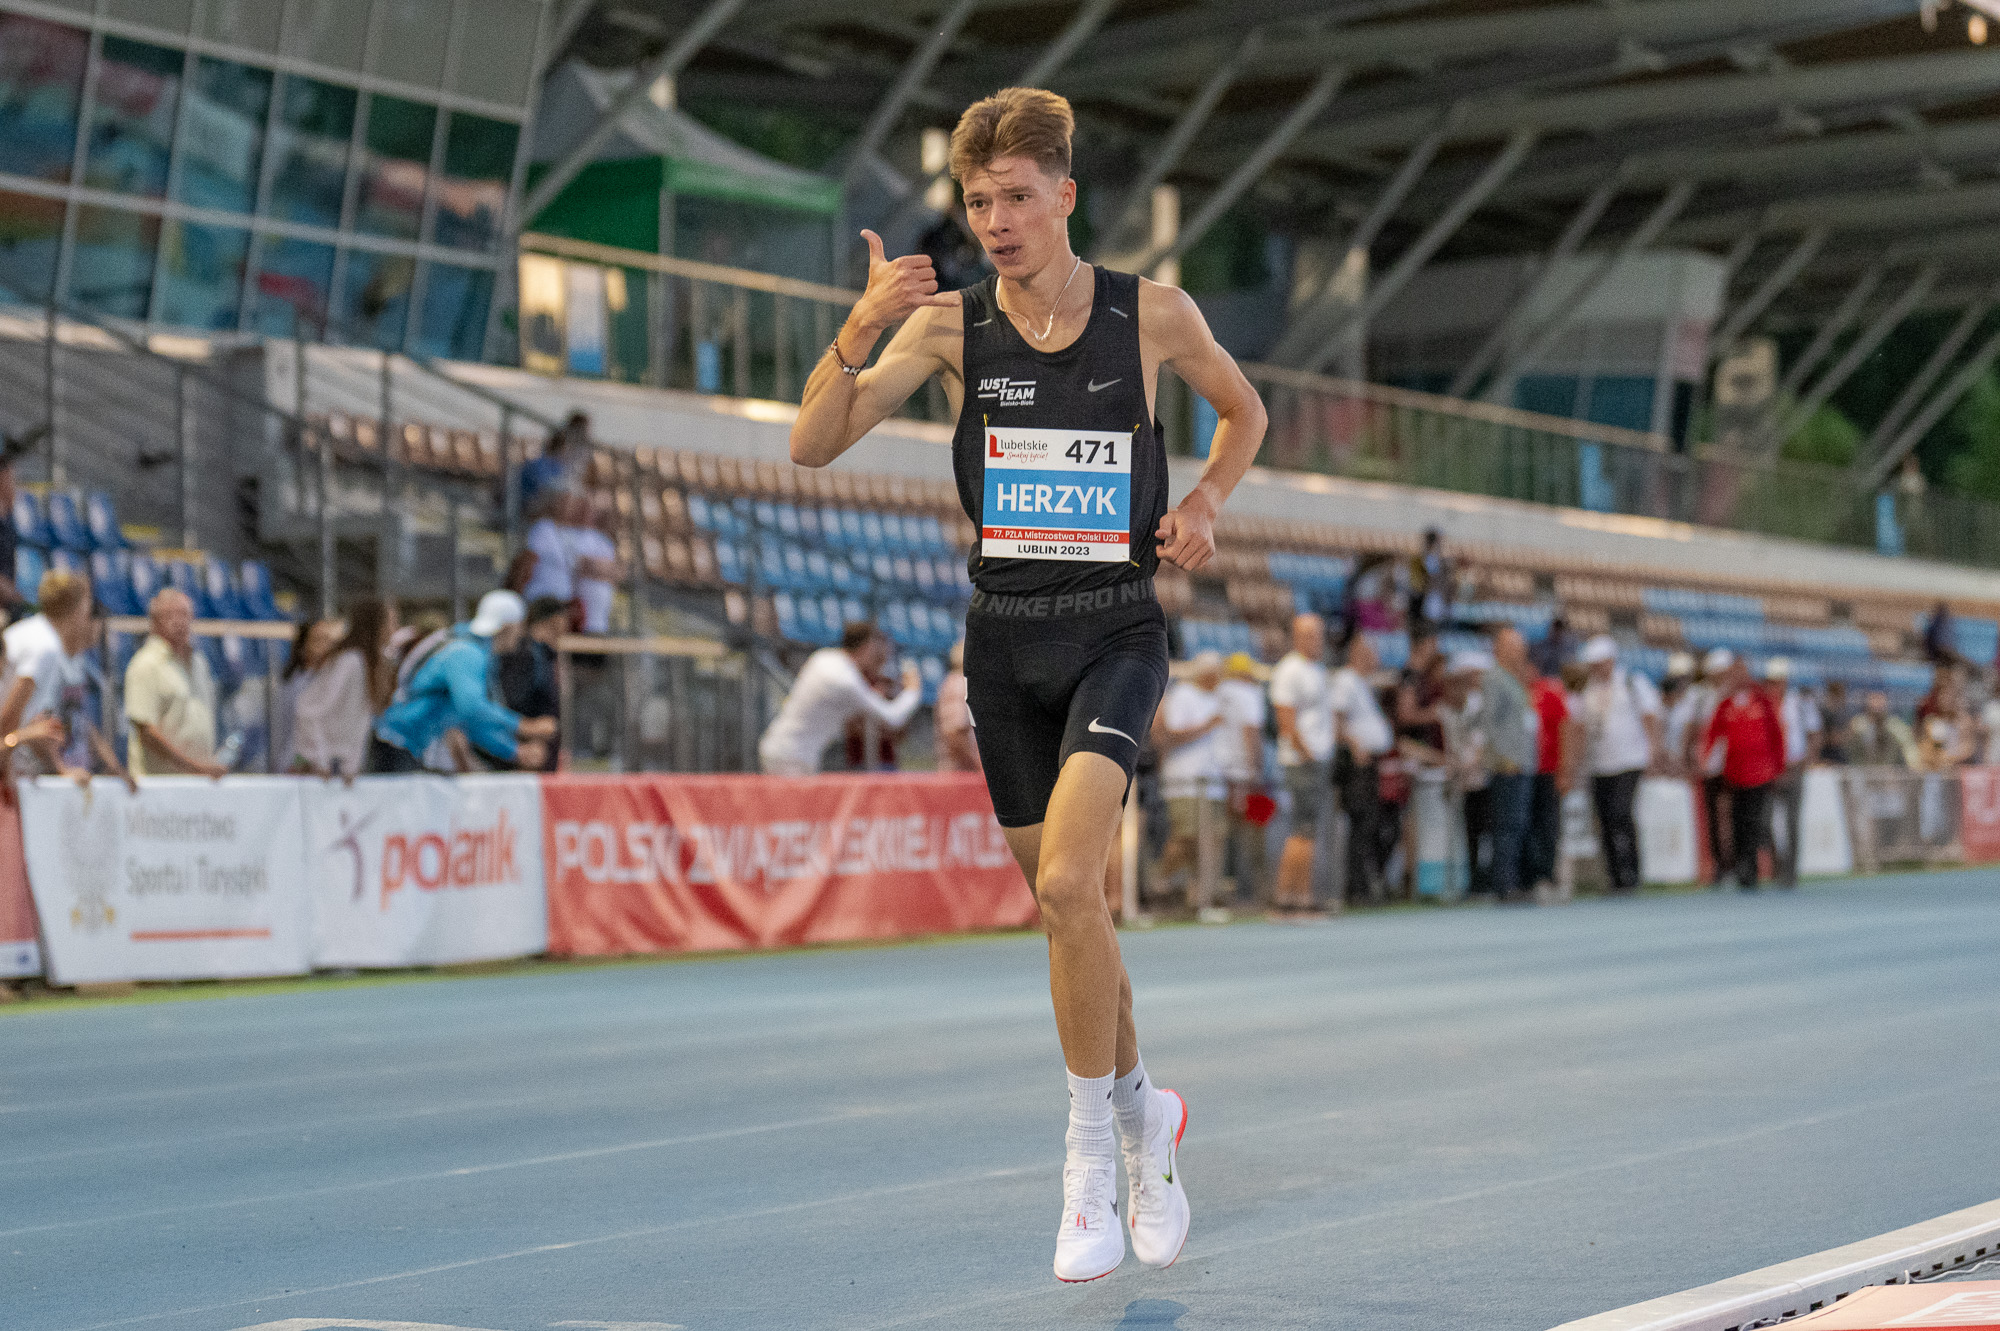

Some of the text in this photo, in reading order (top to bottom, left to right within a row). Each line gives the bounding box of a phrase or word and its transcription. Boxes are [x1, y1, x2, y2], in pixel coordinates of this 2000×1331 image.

[978, 377, 1010, 391] JUST
[999, 387, 1036, 401] TEAM
[1065, 439, 1117, 465] 471
[997, 483, 1117, 515] HERZYK
[993, 529, 1119, 542] 77. PZLA Mistrzostwa Polski U20
[1018, 544, 1090, 556] LUBLIN 2023
[985, 593, 1051, 617] NIKE
[1054, 586, 1114, 616] PRO
[943, 810, 1013, 868] ATLE
